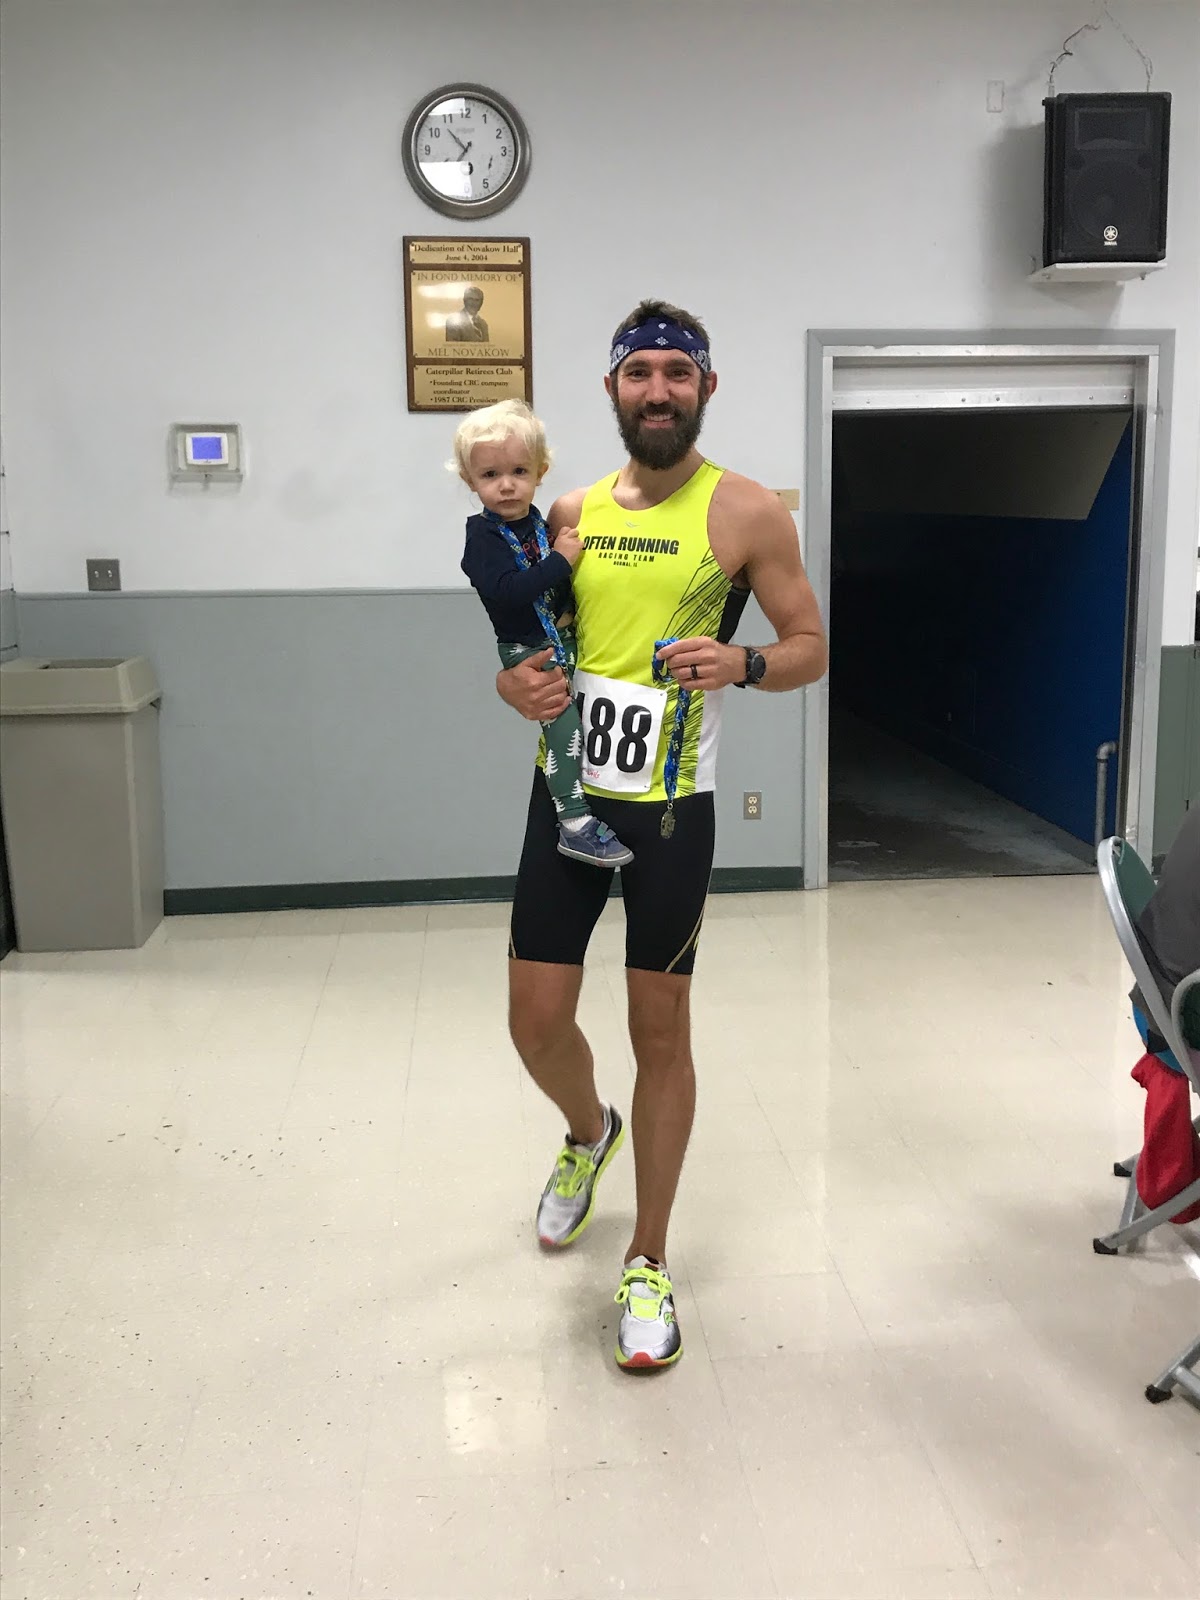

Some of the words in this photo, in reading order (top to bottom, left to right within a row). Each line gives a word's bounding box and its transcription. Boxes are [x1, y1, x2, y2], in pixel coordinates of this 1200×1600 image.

[443, 113, 453, 124] 11
[460, 108, 471, 119] 12
[481, 114, 487, 124] 1
[428, 127, 441, 138] 10
[495, 128, 502, 139] 2
[424, 144, 431, 156] 9
[500, 146, 507, 157] 3
[482, 178, 489, 189] 5
[414, 244, 455, 252] Dedication
[457, 244, 465, 252] of
[502, 245, 519, 253] Hall
[417, 273, 428, 281] IN
[431, 273, 458, 281] FOND
[460, 273, 502, 282] MEMORY
[505, 274, 518, 282] OF
[428, 348, 449, 357] MEL
[453, 348, 510, 357] NOVAKOW
[426, 368, 463, 376] Caterpillar
[433, 379, 462, 387] Founding
[582, 536, 617, 551] OFTEN
[617, 536, 680, 556] RUNNING
[598, 552, 628, 561] RACING
[633, 554, 655, 562] TEAM
